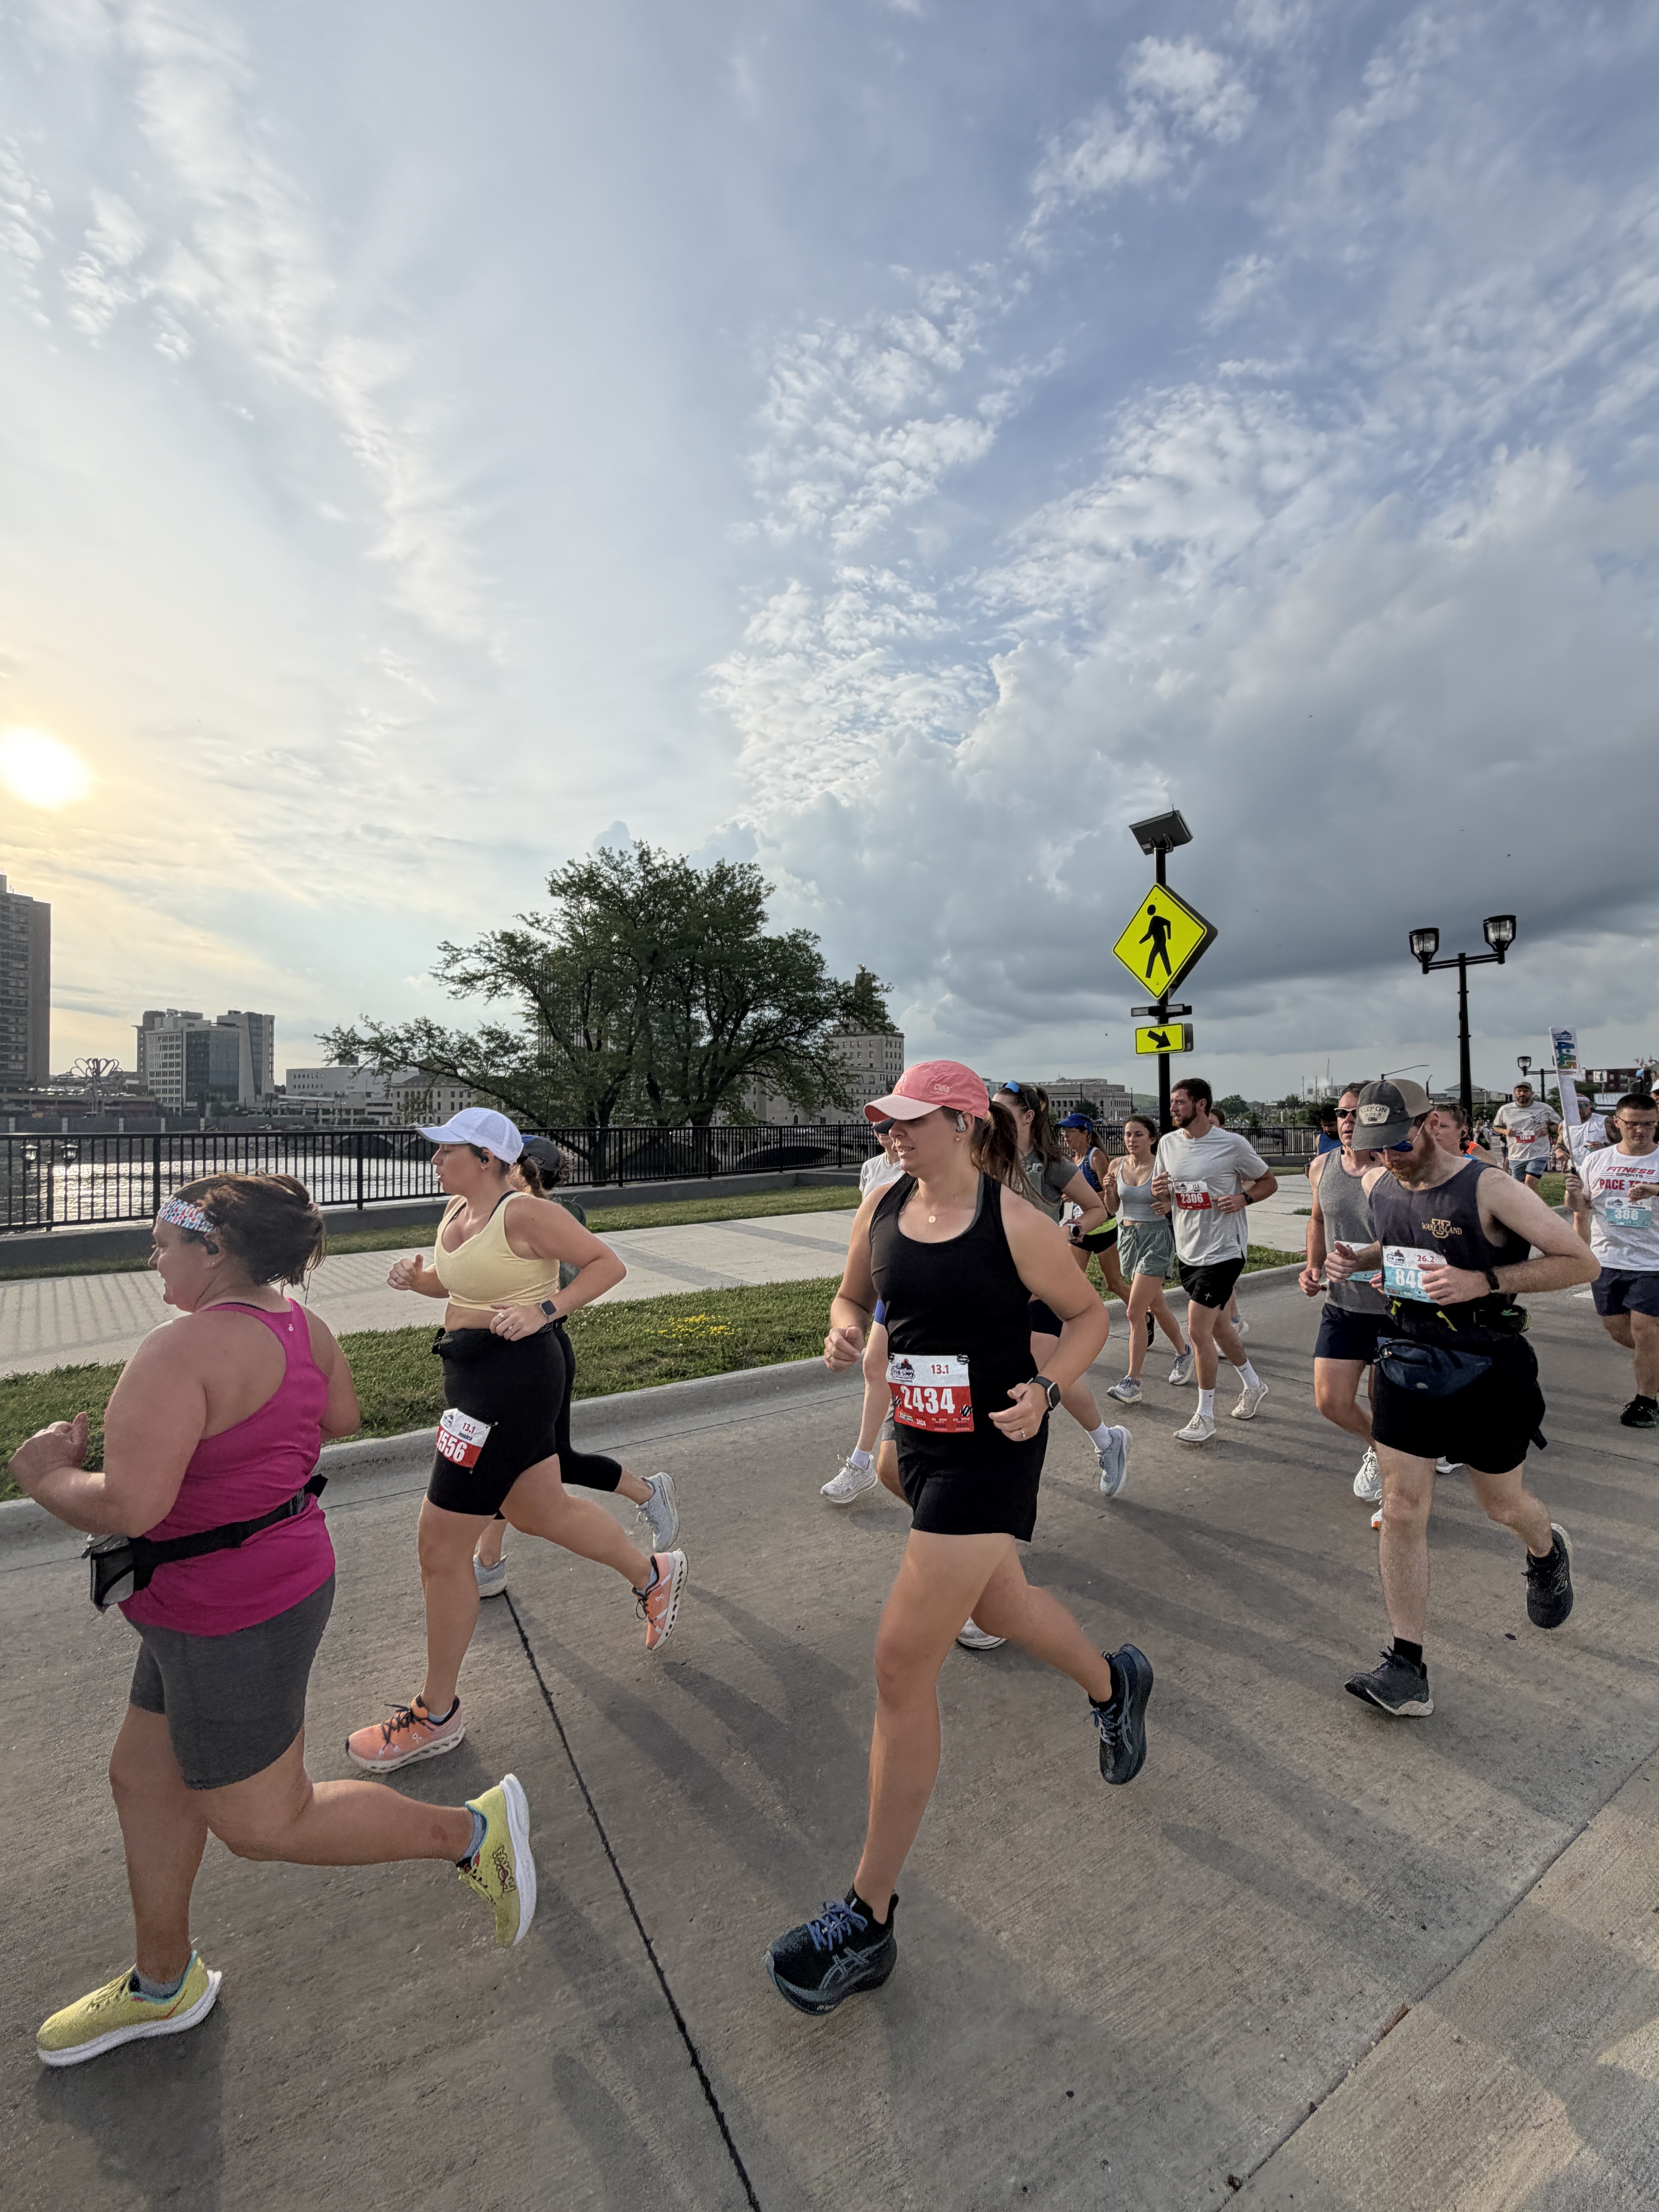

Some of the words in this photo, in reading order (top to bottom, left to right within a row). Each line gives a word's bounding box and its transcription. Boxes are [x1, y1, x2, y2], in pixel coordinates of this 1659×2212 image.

[1606, 1166, 1656, 1175] FITNESS
[1600, 1179, 1625, 1190] PACE
[1181, 1193, 1203, 1203] 2306
[1422, 1222, 1438, 1232] WAKE
[1439, 1225, 1462, 1235] ISLAND
[931, 1364, 949, 1374] 13.1
[900, 1385, 955, 1414] 2434
[463, 1422, 476, 1434] 13.1
[437, 1430, 467, 1462] 1556
